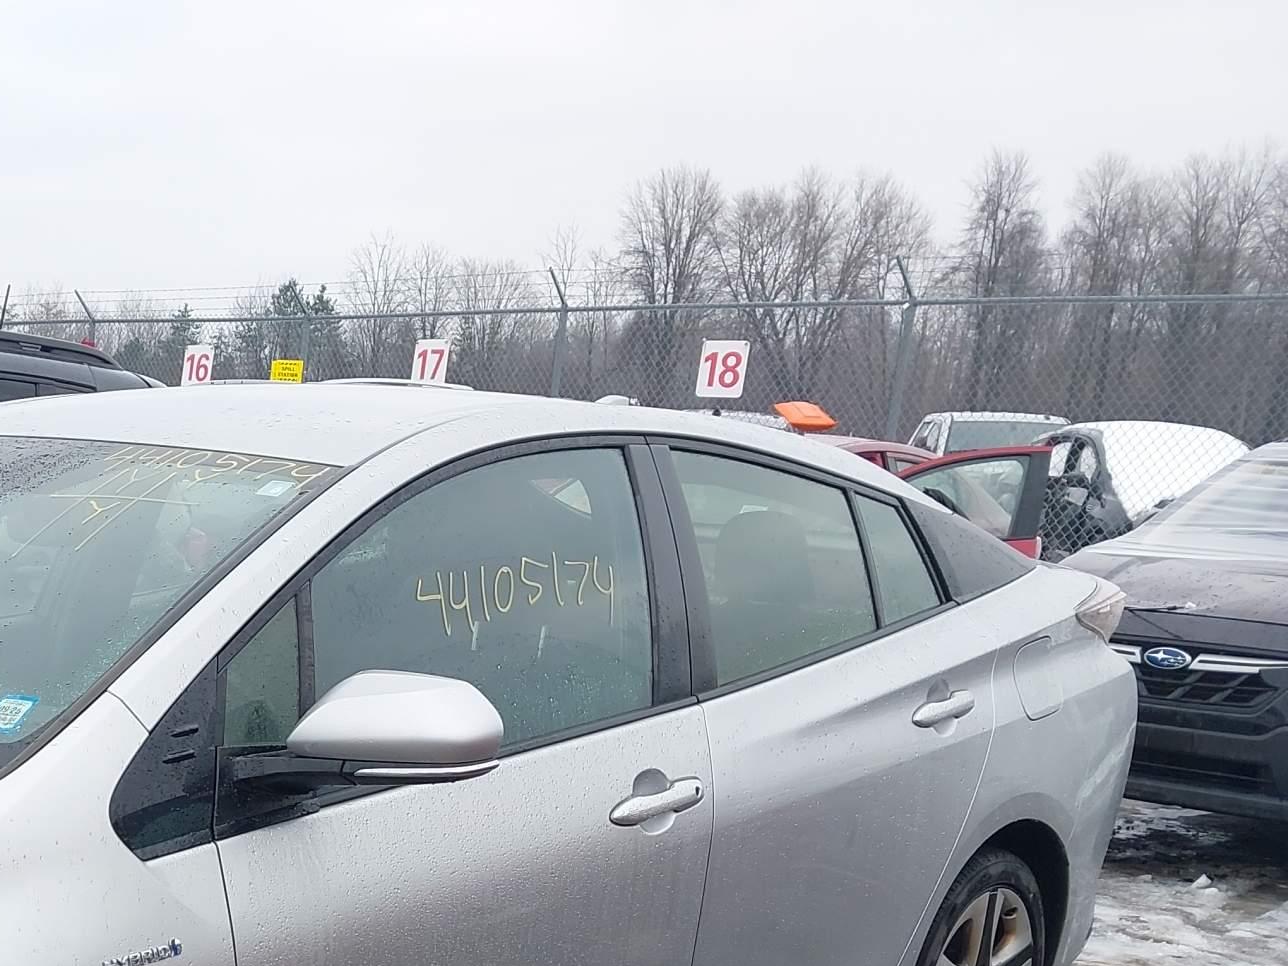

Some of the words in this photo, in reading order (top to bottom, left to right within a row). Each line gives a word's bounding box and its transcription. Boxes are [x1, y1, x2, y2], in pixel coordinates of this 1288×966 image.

[186, 353, 210, 382] 16
[417, 349, 445, 380] 17
[703, 351, 743, 389] 18
[103, 446, 332, 490] 44105174
